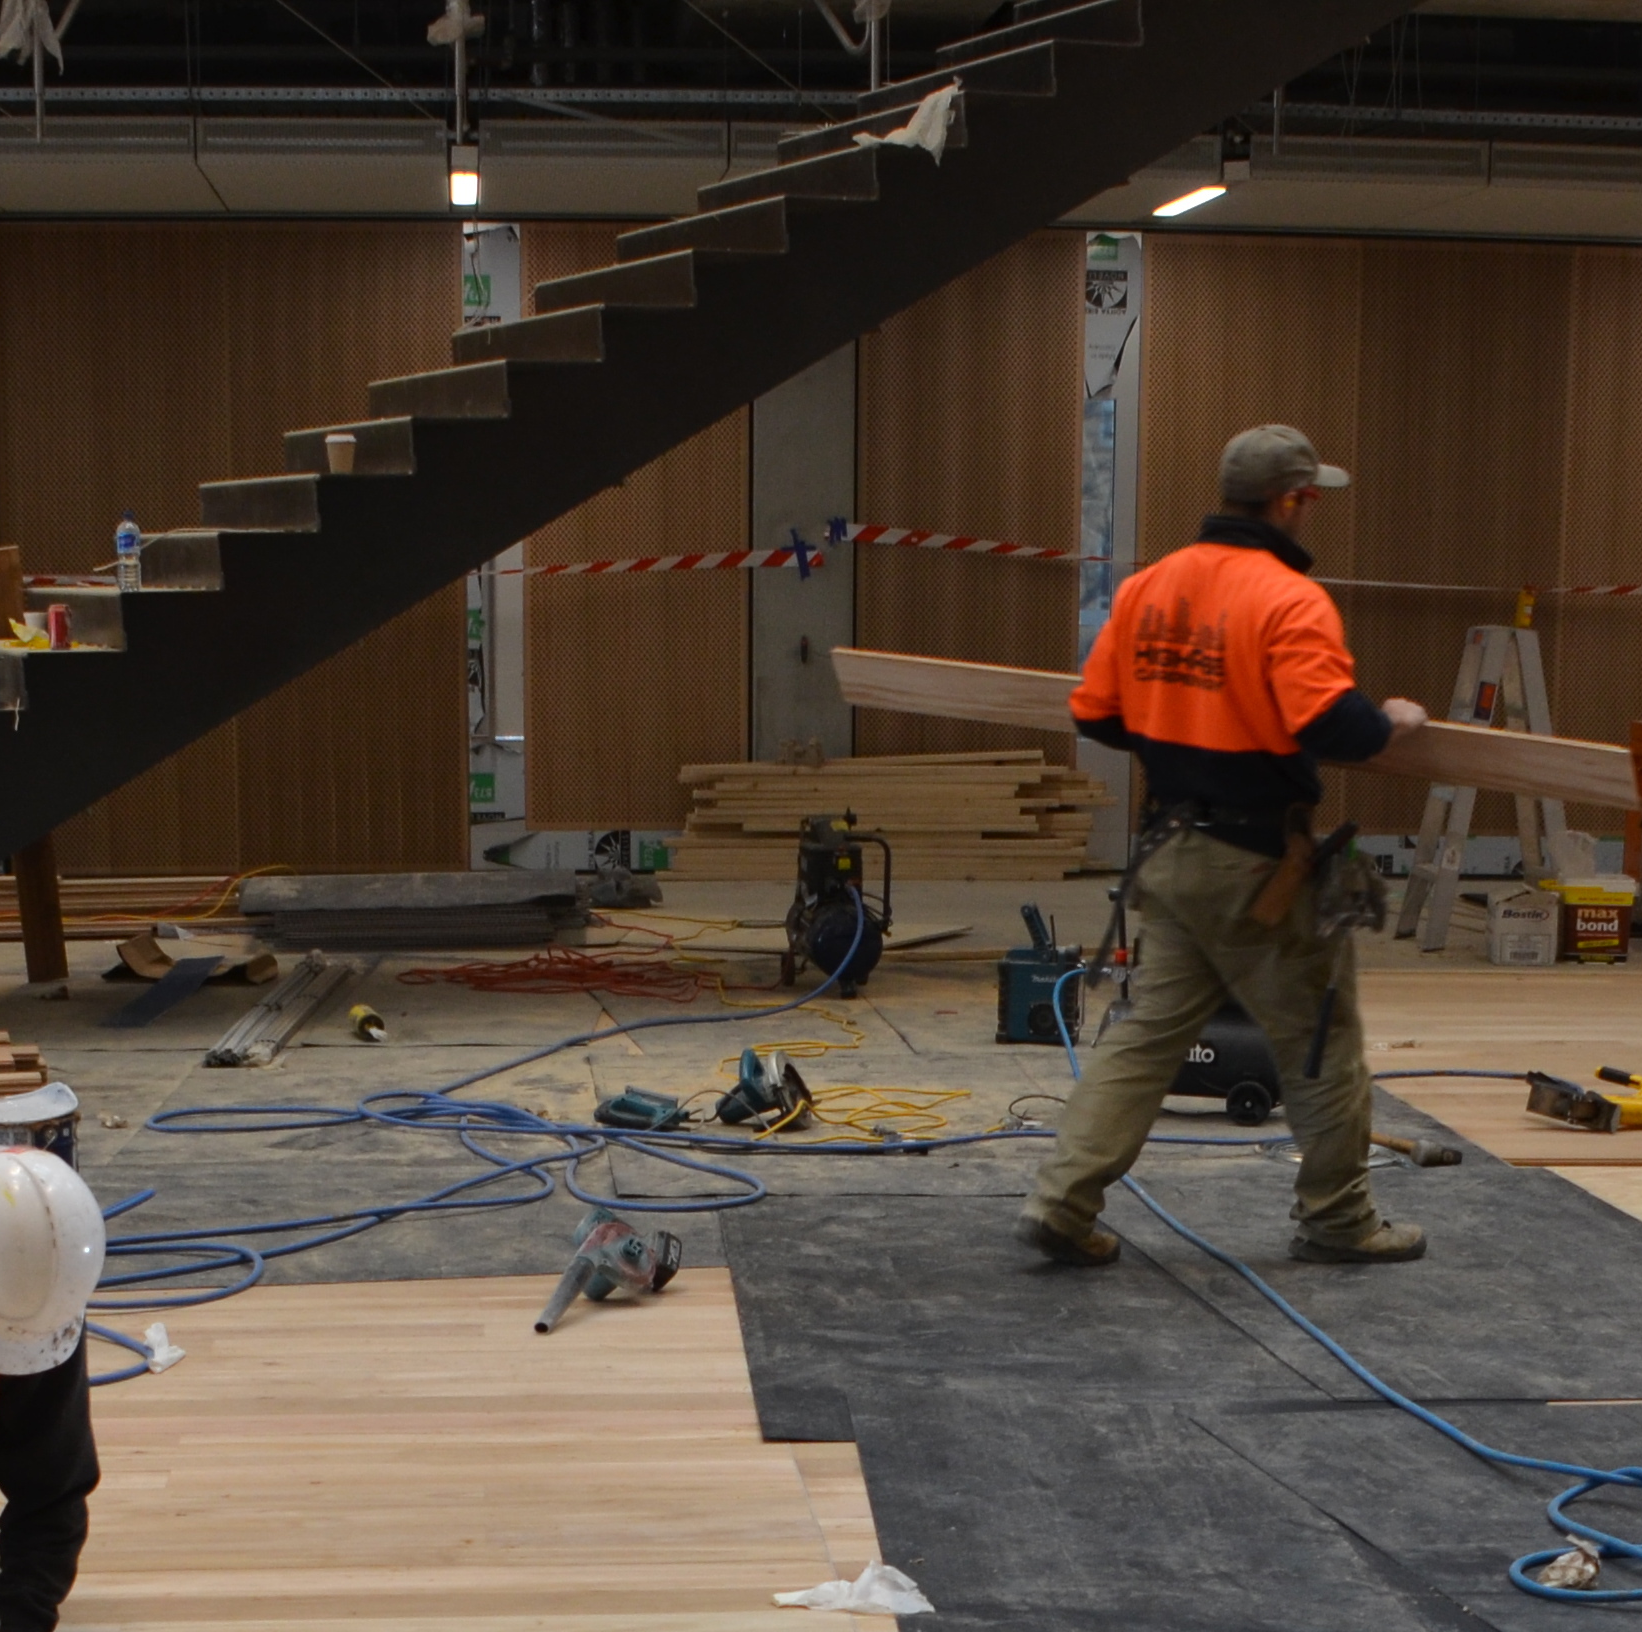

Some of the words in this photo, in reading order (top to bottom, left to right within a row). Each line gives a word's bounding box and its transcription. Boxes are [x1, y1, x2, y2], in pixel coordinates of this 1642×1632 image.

[1501, 909, 1544, 920] Bostik
[1577, 908, 1619, 919] max
[1576, 919, 1619, 932] bond
[1031, 975, 1058, 983] Makit
